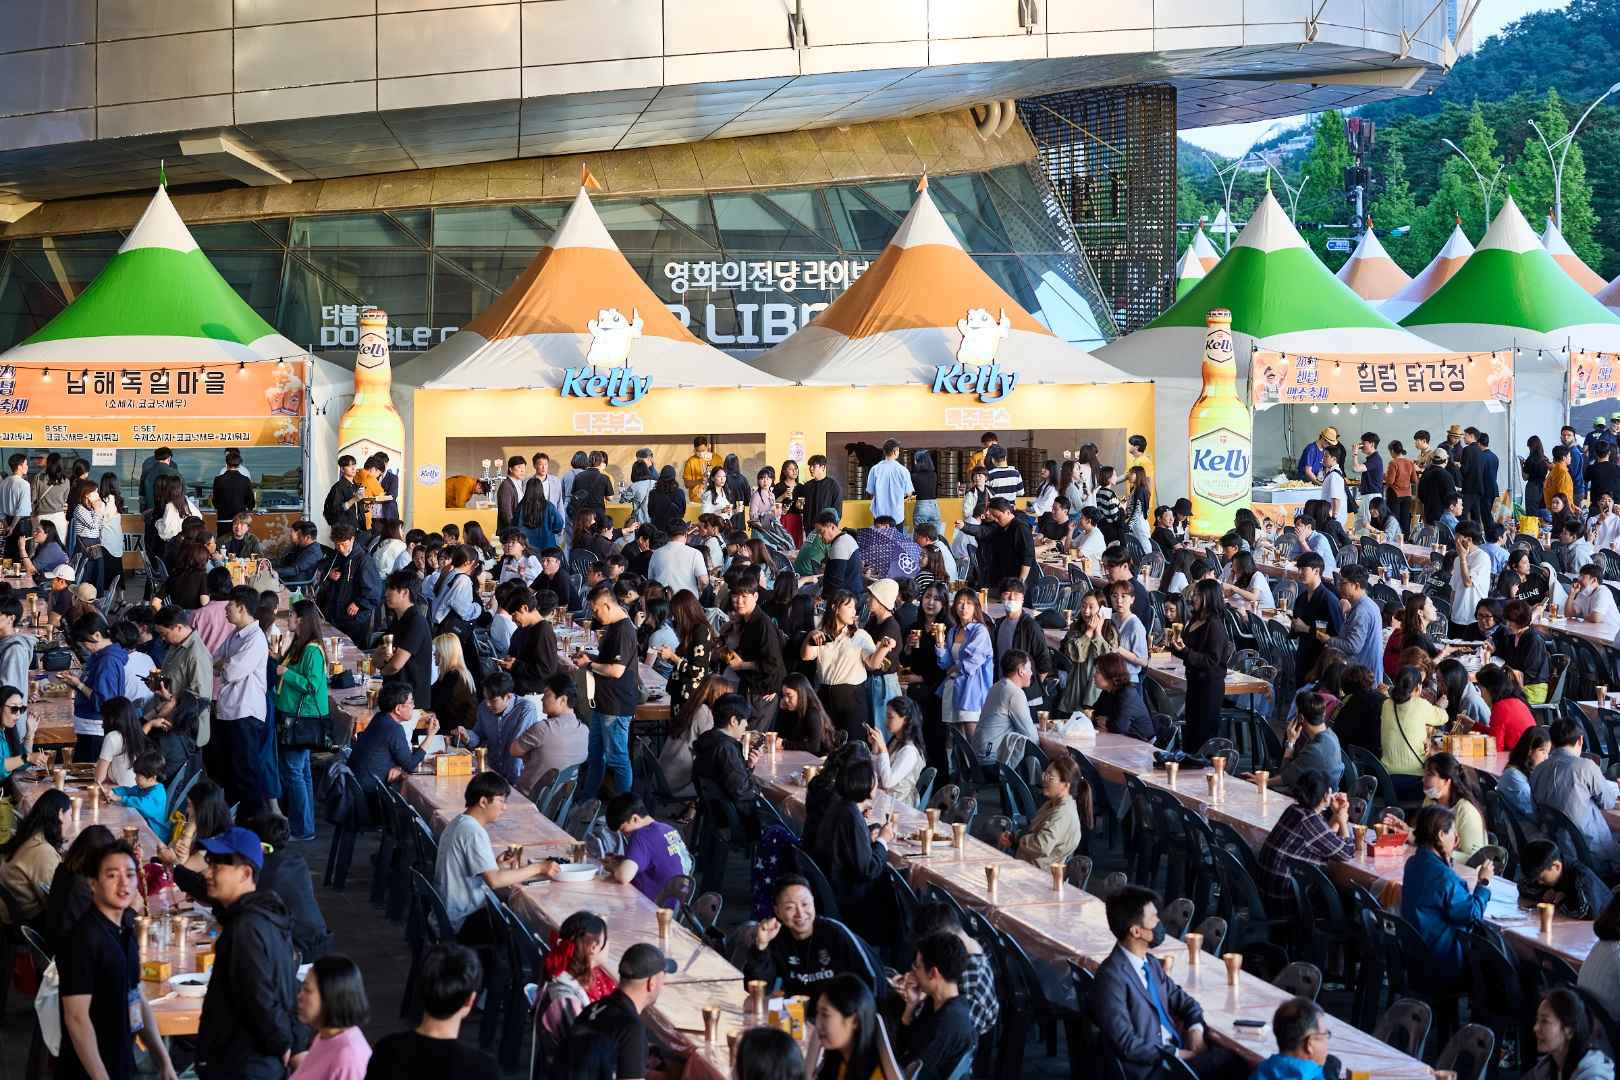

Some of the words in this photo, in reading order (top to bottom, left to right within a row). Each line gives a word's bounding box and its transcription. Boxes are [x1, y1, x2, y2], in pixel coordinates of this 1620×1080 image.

[664, 260, 800, 293] 영화의전당
[322, 304, 377, 326] 더블
[67, 371, 225, 395] 남해독일마을
[560, 367, 653, 407] Kelly
[932, 364, 1019, 403] Kelly
[1405, 364, 1465, 392] 닭강정
[1193, 449, 1249, 478] Kelly
